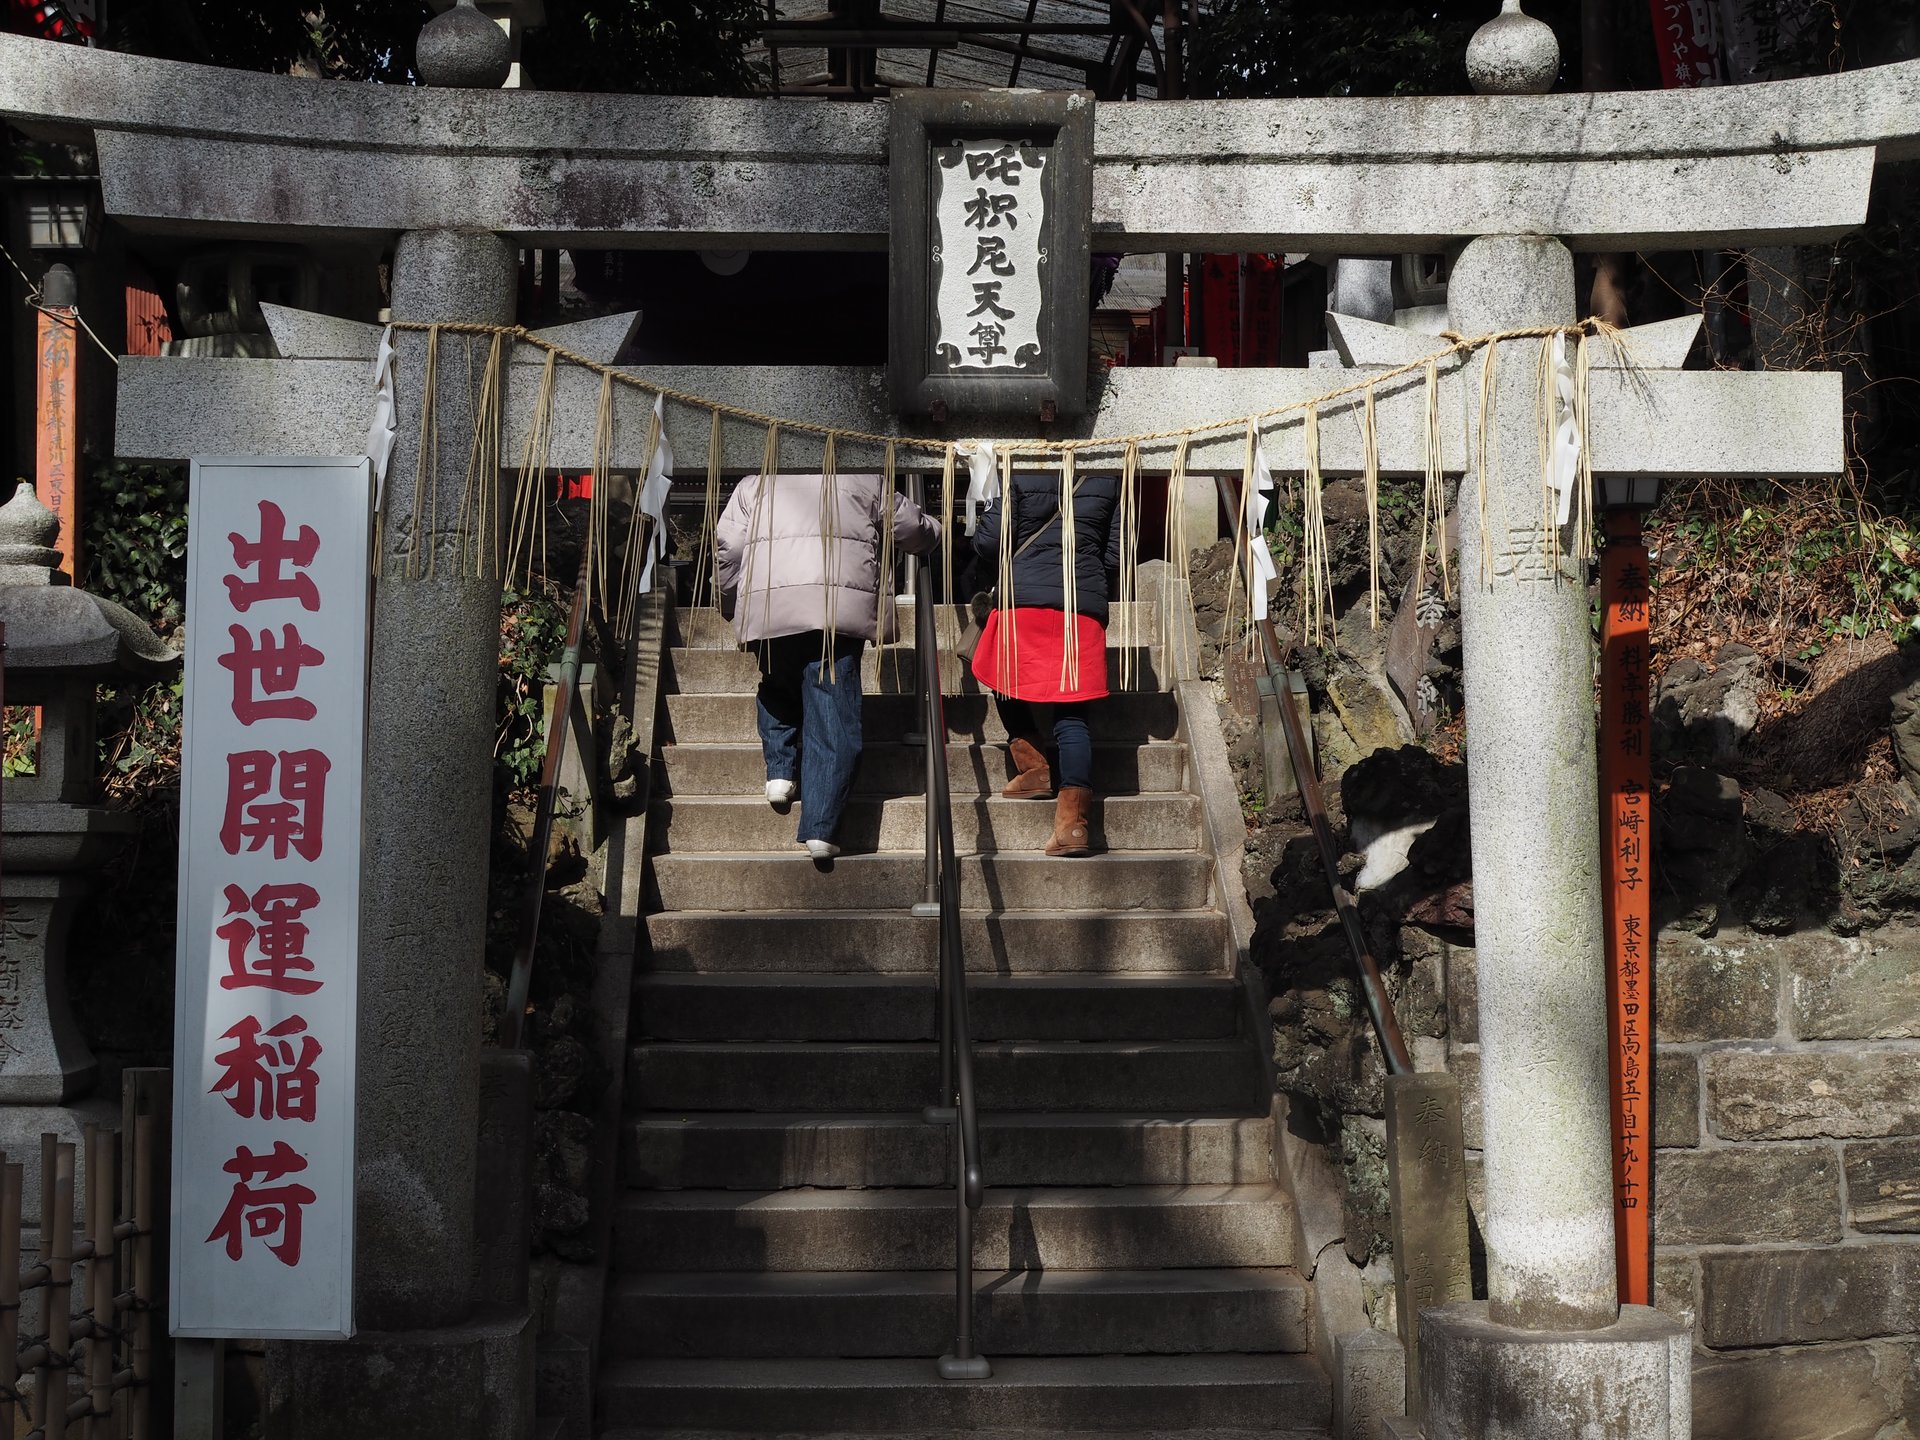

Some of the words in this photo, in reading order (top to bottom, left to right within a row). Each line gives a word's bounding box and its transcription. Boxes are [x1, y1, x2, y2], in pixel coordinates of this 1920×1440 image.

[1616, 563, 1647, 624] 奉納
[1619, 645, 1646, 757] 料亭勝利
[205, 500, 332, 1268] 出世開運稲荷
[1415, 1095, 1450, 1169] 奉納
